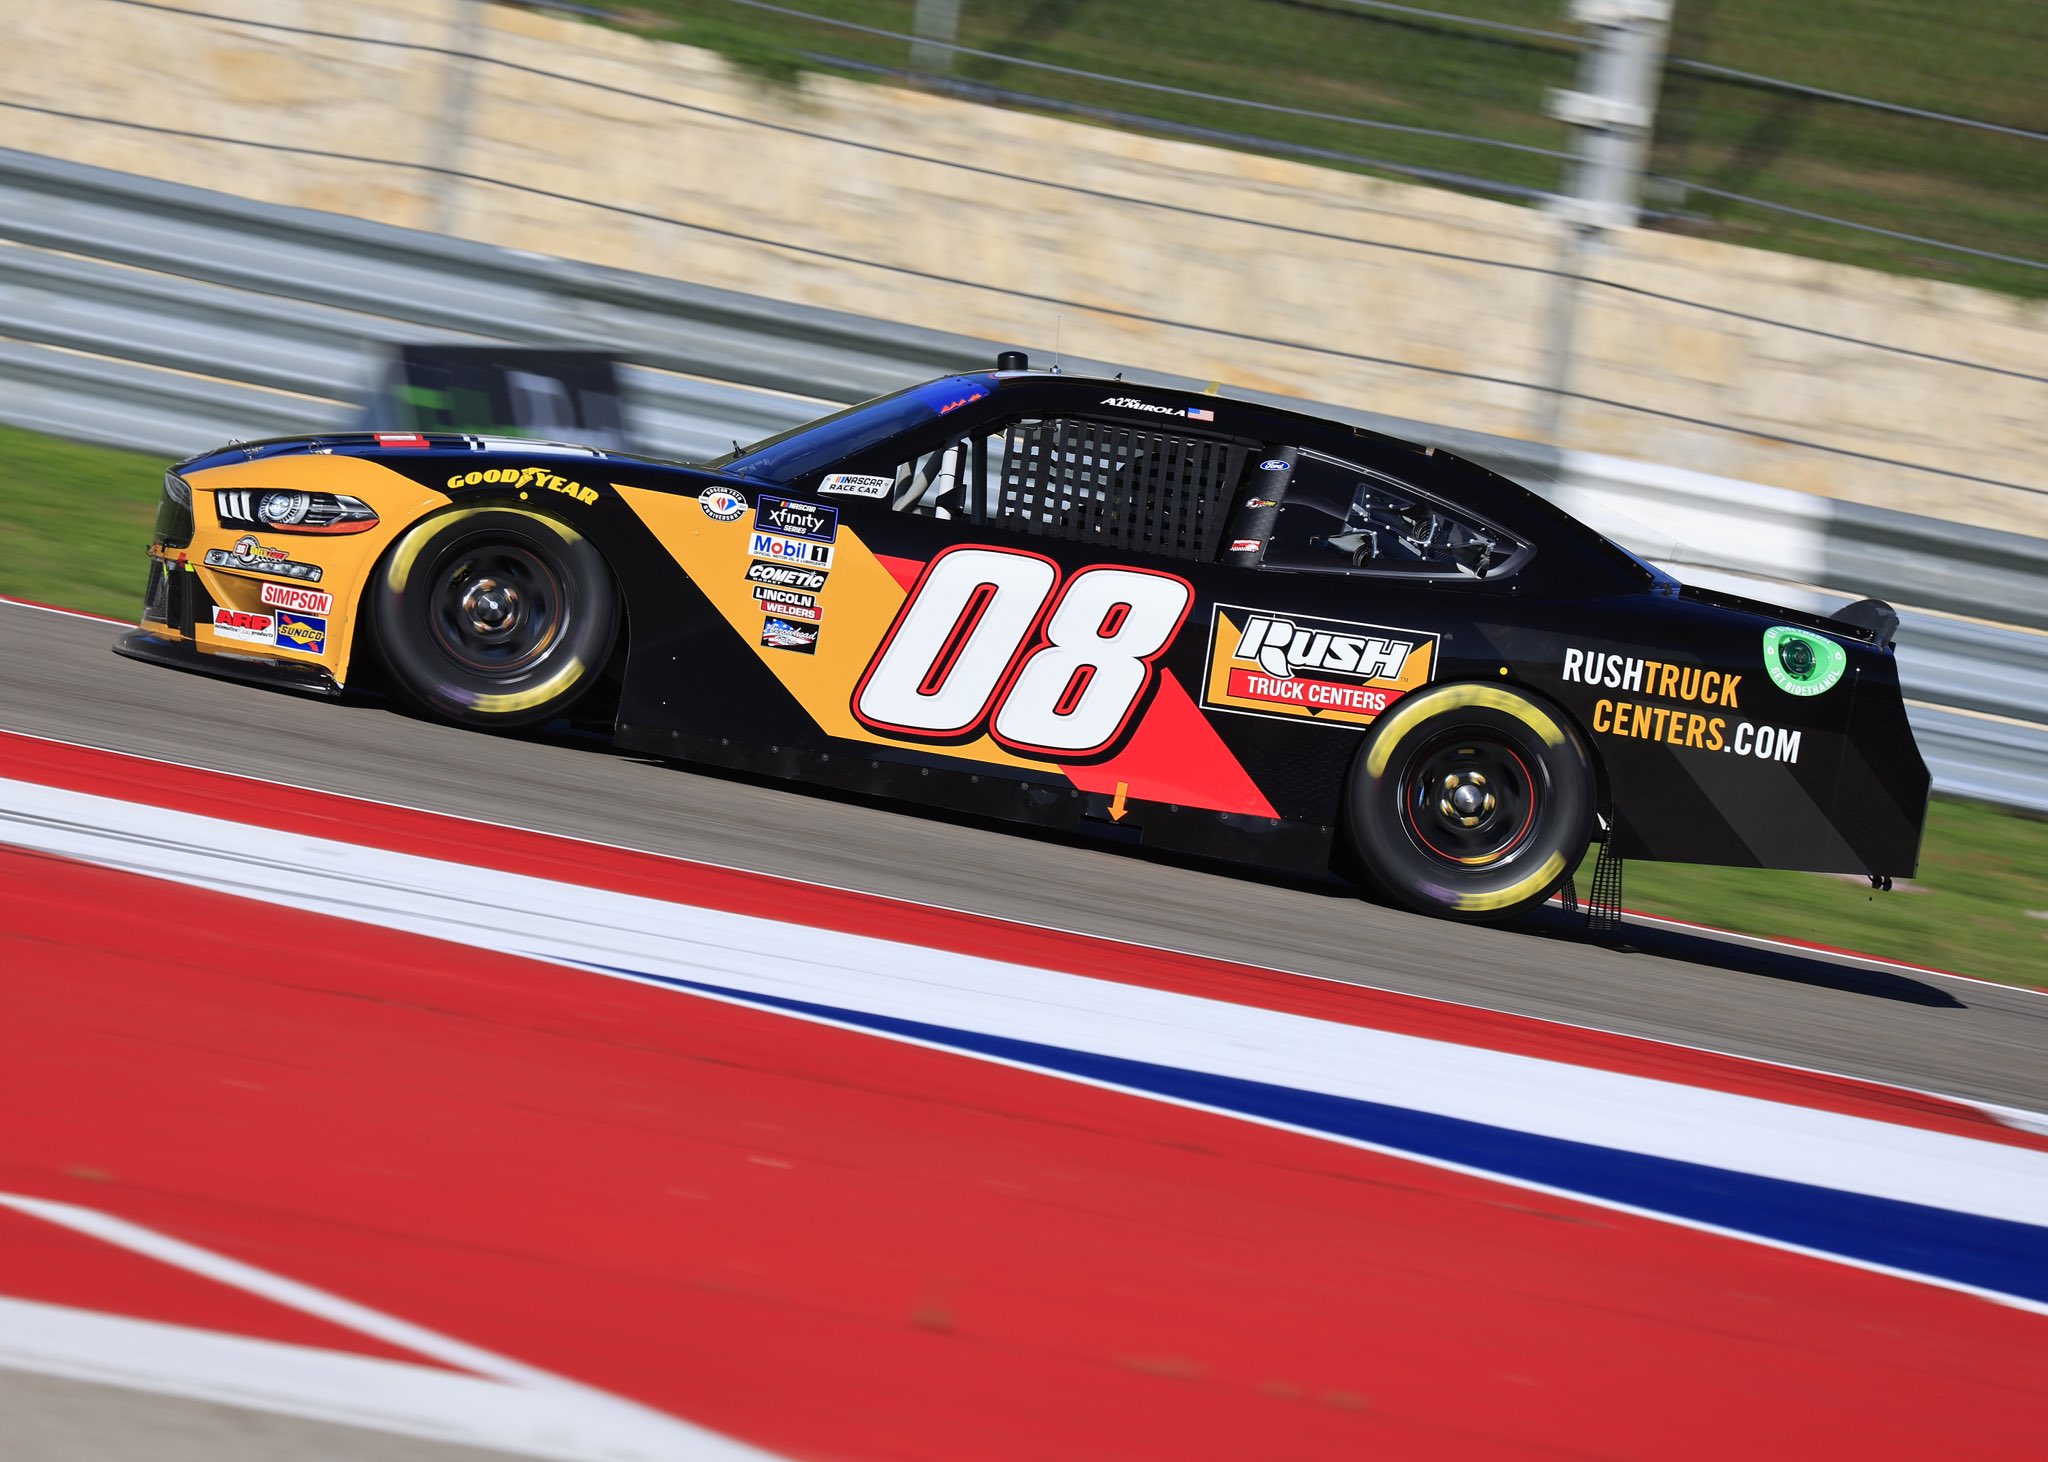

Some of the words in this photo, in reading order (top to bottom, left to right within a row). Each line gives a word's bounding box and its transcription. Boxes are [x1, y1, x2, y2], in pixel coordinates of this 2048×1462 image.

[1099, 397, 1186, 417] ALMIROLA
[1263, 460, 1286, 470] Ford
[447, 468, 599, 506] GOODYEAR
[829, 484, 856, 492] RACE
[858, 486, 879, 494] CAR
[844, 476, 884, 487] NASCAR
[789, 502, 817, 513] NASCAR
[769, 508, 825, 533] xfinity
[783, 524, 807, 535] SERIES
[754, 535, 807, 559] Mobil
[749, 565, 825, 588] COMETIC
[264, 586, 328, 612] SIMPSON
[755, 587, 812, 607] LINCOLN
[215, 609, 272, 631] ARP
[766, 602, 816, 619] WELDERS
[280, 626, 323, 641] SUNOCO
[851, 544, 1195, 758] 08
[1562, 648, 1742, 708] RUSHTRUCK
[1771, 667, 1786, 684] GET
[1785, 670, 1841, 696] BIOETHANOL
[1247, 675, 1304, 700] TRUCK
[1308, 684, 1386, 711] CENTERS
[1593, 699, 1802, 764] CENTERS.COM
